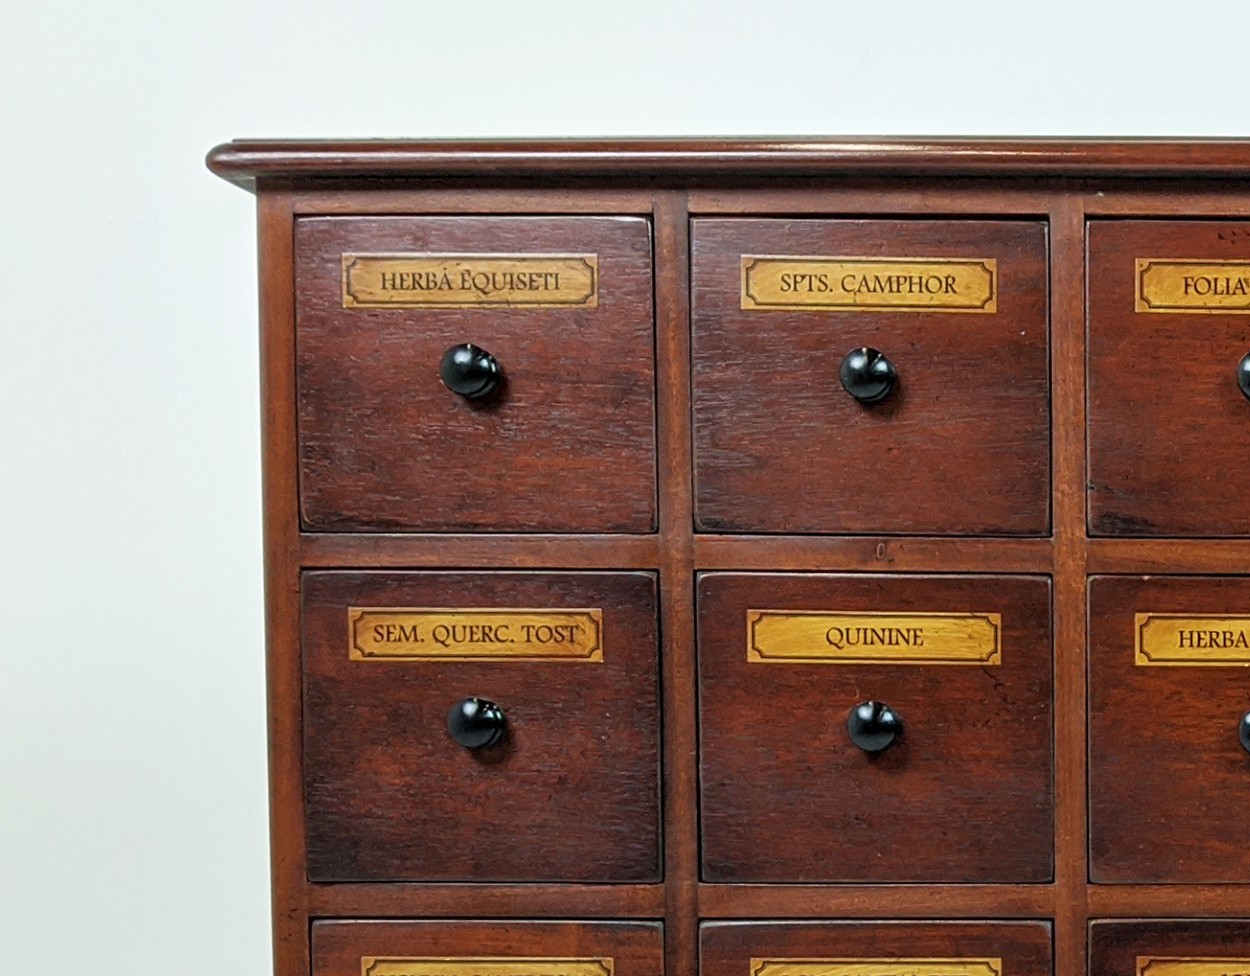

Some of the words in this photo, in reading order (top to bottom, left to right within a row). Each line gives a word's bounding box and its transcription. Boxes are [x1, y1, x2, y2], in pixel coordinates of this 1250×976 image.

[380, 272, 453, 290] HERBA
[460, 271, 560, 295] EQUISETI
[780, 274, 833, 293] SPTS.
[841, 274, 958, 294] CAMPHOR
[1183, 276, 1249, 295] FOLIA
[373, 624, 424, 643] SEM.
[432, 624, 514, 647] QUERC.
[521, 625, 578, 643] TOST
[826, 627, 924, 649] QUININE
[1179, 630, 1249, 649] HERBA
